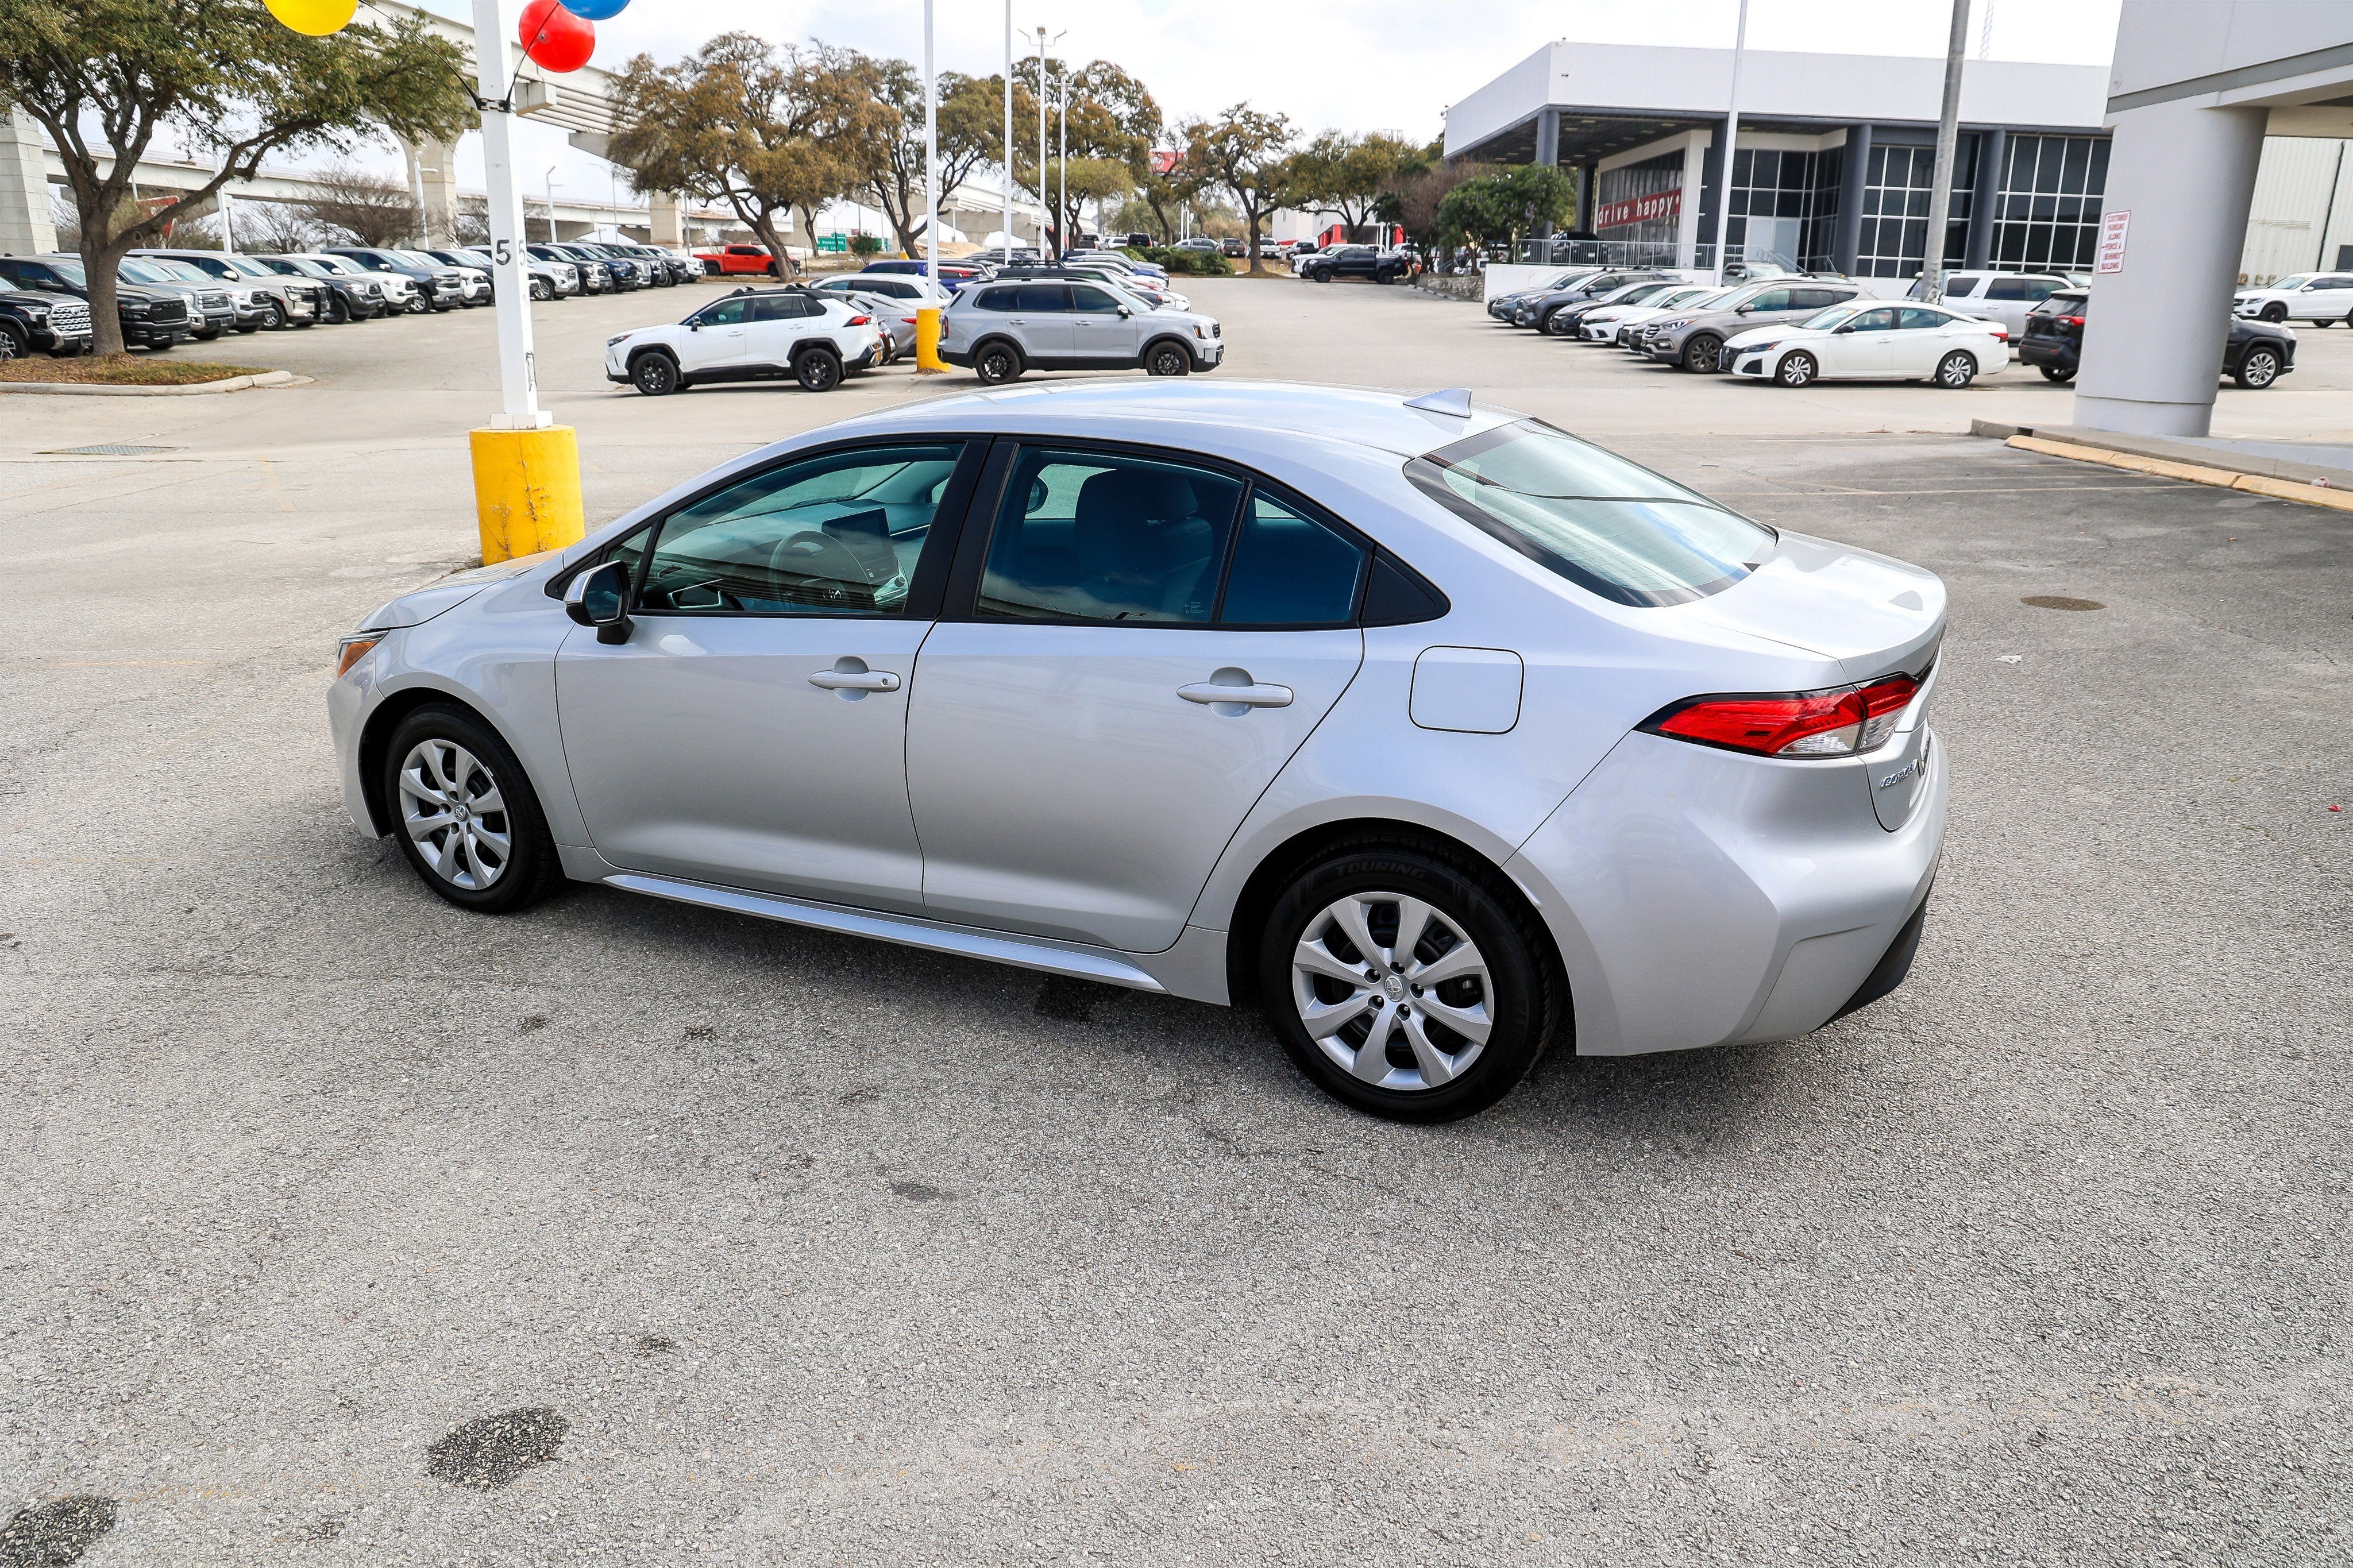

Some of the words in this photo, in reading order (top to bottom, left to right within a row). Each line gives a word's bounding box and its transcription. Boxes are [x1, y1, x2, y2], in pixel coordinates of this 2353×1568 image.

[1598, 203, 1629, 225] drive
[2108, 232, 2121, 240] ALONG
[496, 238, 511, 265] 5
[519, 240, 526, 265] 5
[2101, 262, 2120, 270] BUILDING
[1336, 861, 1427, 879] TOURING
